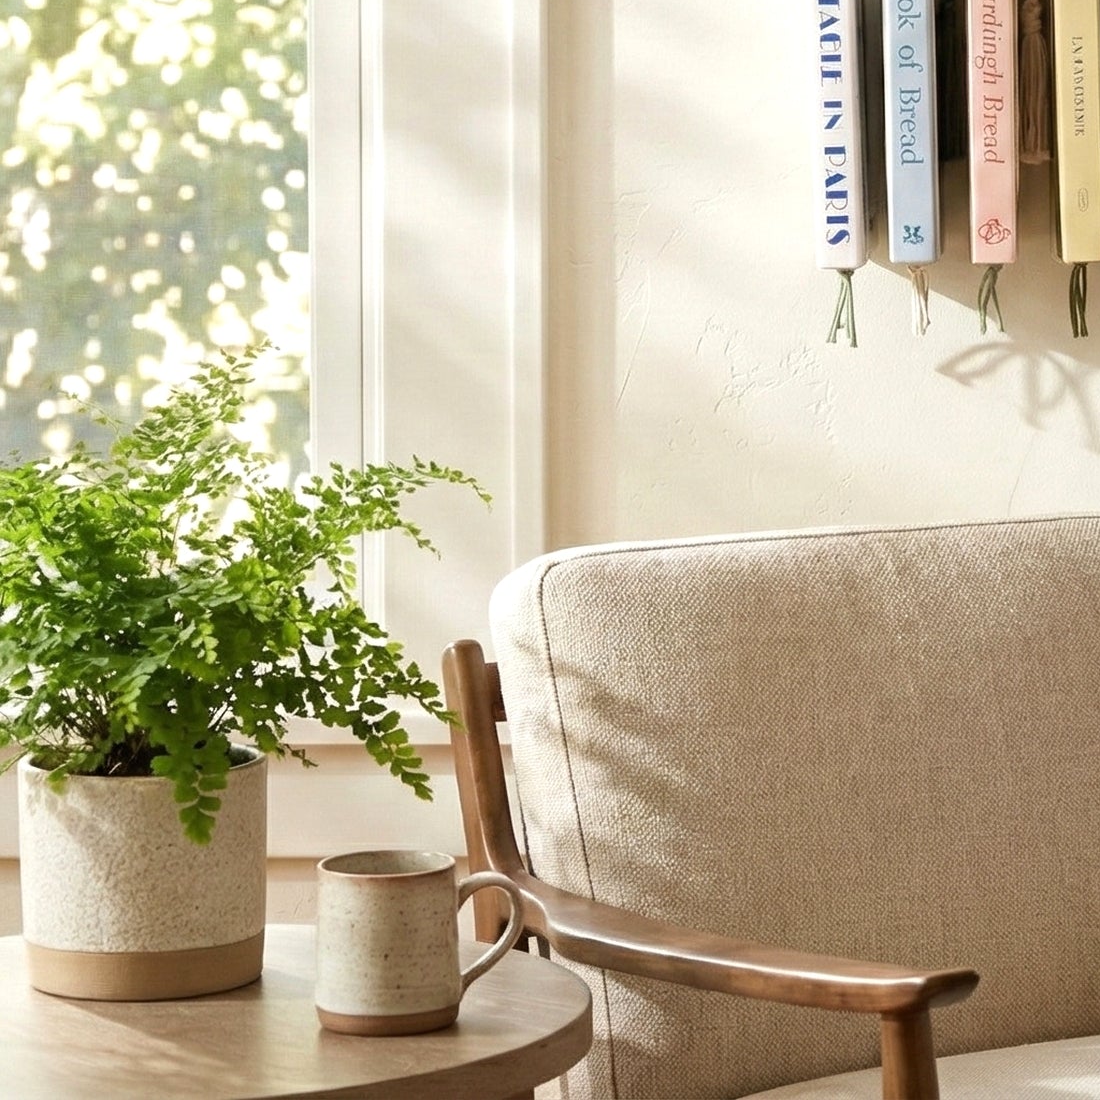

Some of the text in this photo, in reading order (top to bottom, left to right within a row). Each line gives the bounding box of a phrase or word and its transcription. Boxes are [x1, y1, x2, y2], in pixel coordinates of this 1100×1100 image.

[899, 45, 923, 73] of
[823, 101, 843, 130] IN
[900, 87, 925, 165] Bread
[983, 95, 1005, 163] Bread
[823, 145, 850, 246] PARIS
